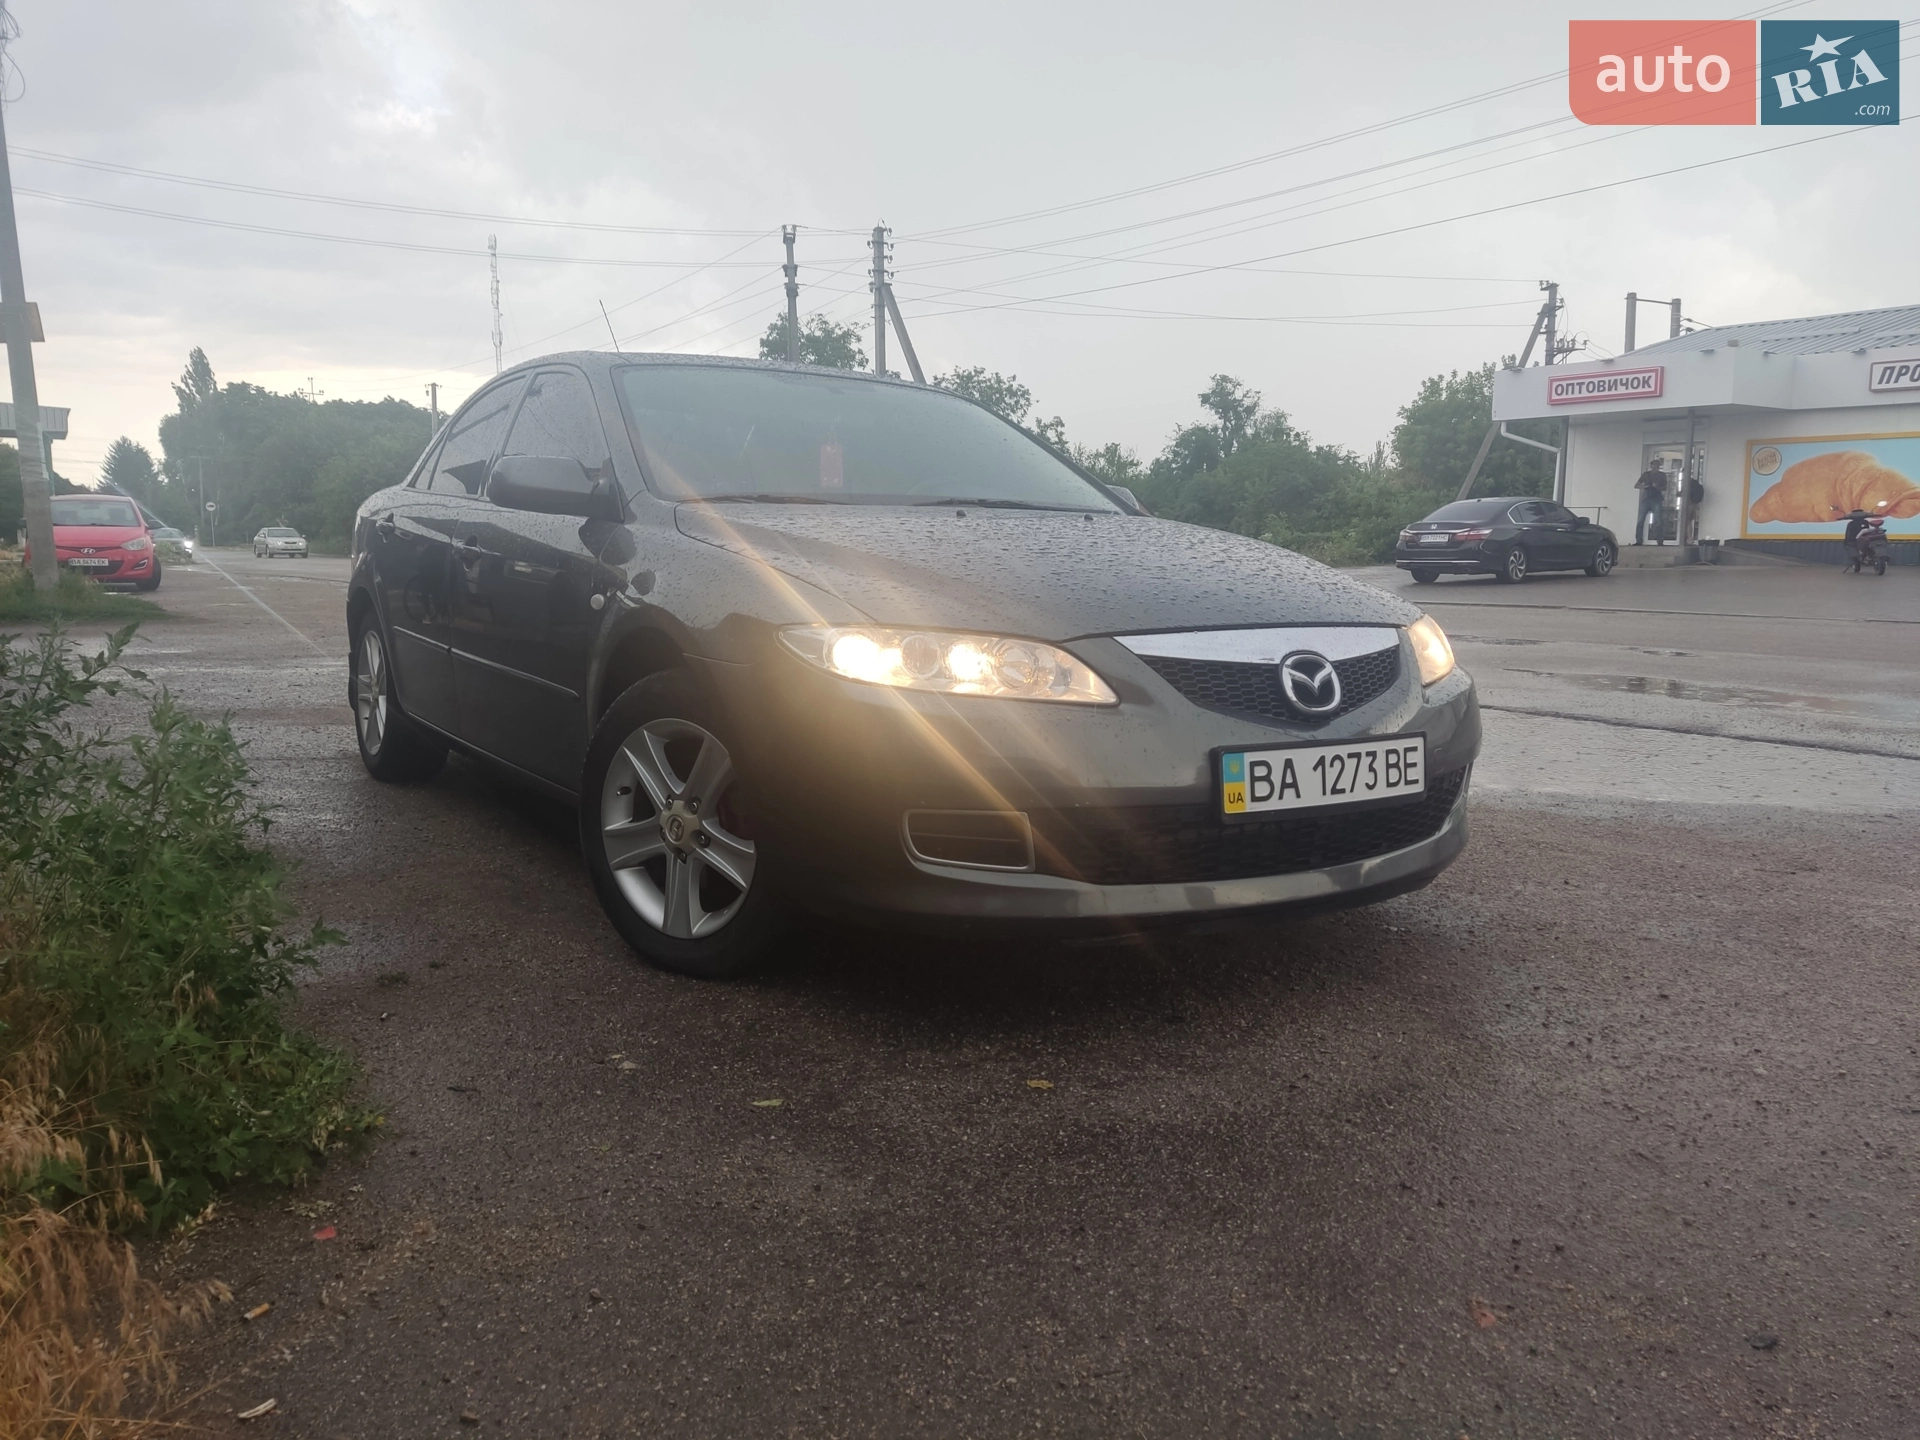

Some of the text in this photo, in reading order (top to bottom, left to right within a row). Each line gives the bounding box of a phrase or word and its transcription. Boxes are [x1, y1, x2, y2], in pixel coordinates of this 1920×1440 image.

[1554, 374, 1653, 397] ОПТОВИЧОК
[1249, 745, 1420, 803] BA 1273 BE
[1228, 792, 1244, 805] UA
